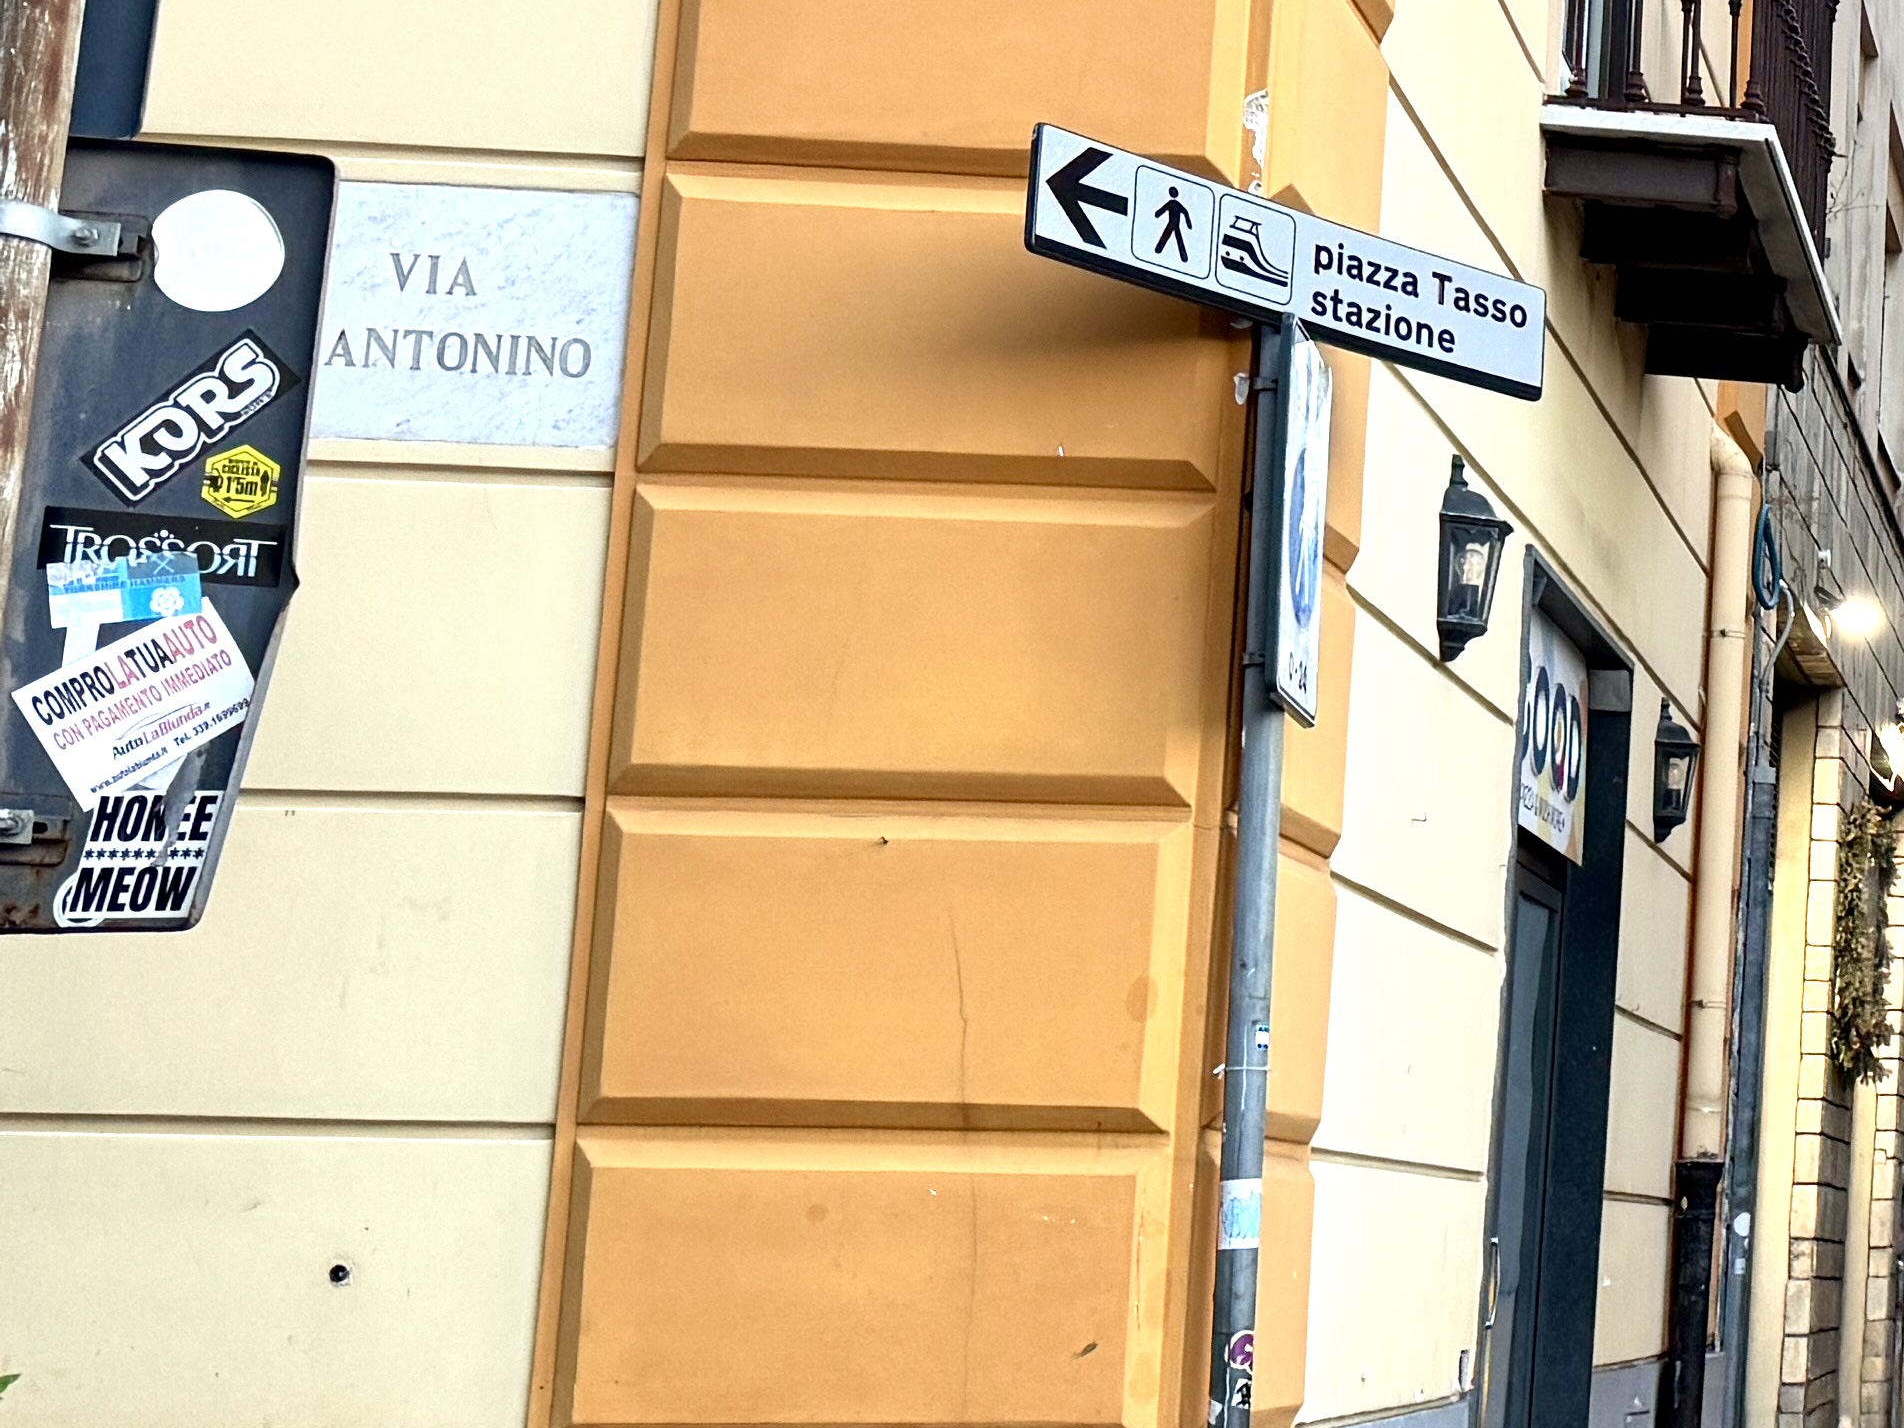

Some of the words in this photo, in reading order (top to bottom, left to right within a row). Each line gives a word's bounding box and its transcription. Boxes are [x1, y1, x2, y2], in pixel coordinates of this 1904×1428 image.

[389, 252, 477, 296] VIA
[1313, 243, 1420, 298] piazza
[1432, 271, 1528, 328] Tasso
[323, 327, 592, 378] ANTONINO
[1310, 288, 1456, 353] stazione
[53, 723, 85, 750] CON
[82, 685, 163, 735] PAGAMENTO
[160, 649, 232, 697] IMMEDIATO
[1522, 665, 1580, 804] OOD
[68, 866, 199, 912] MEOW
